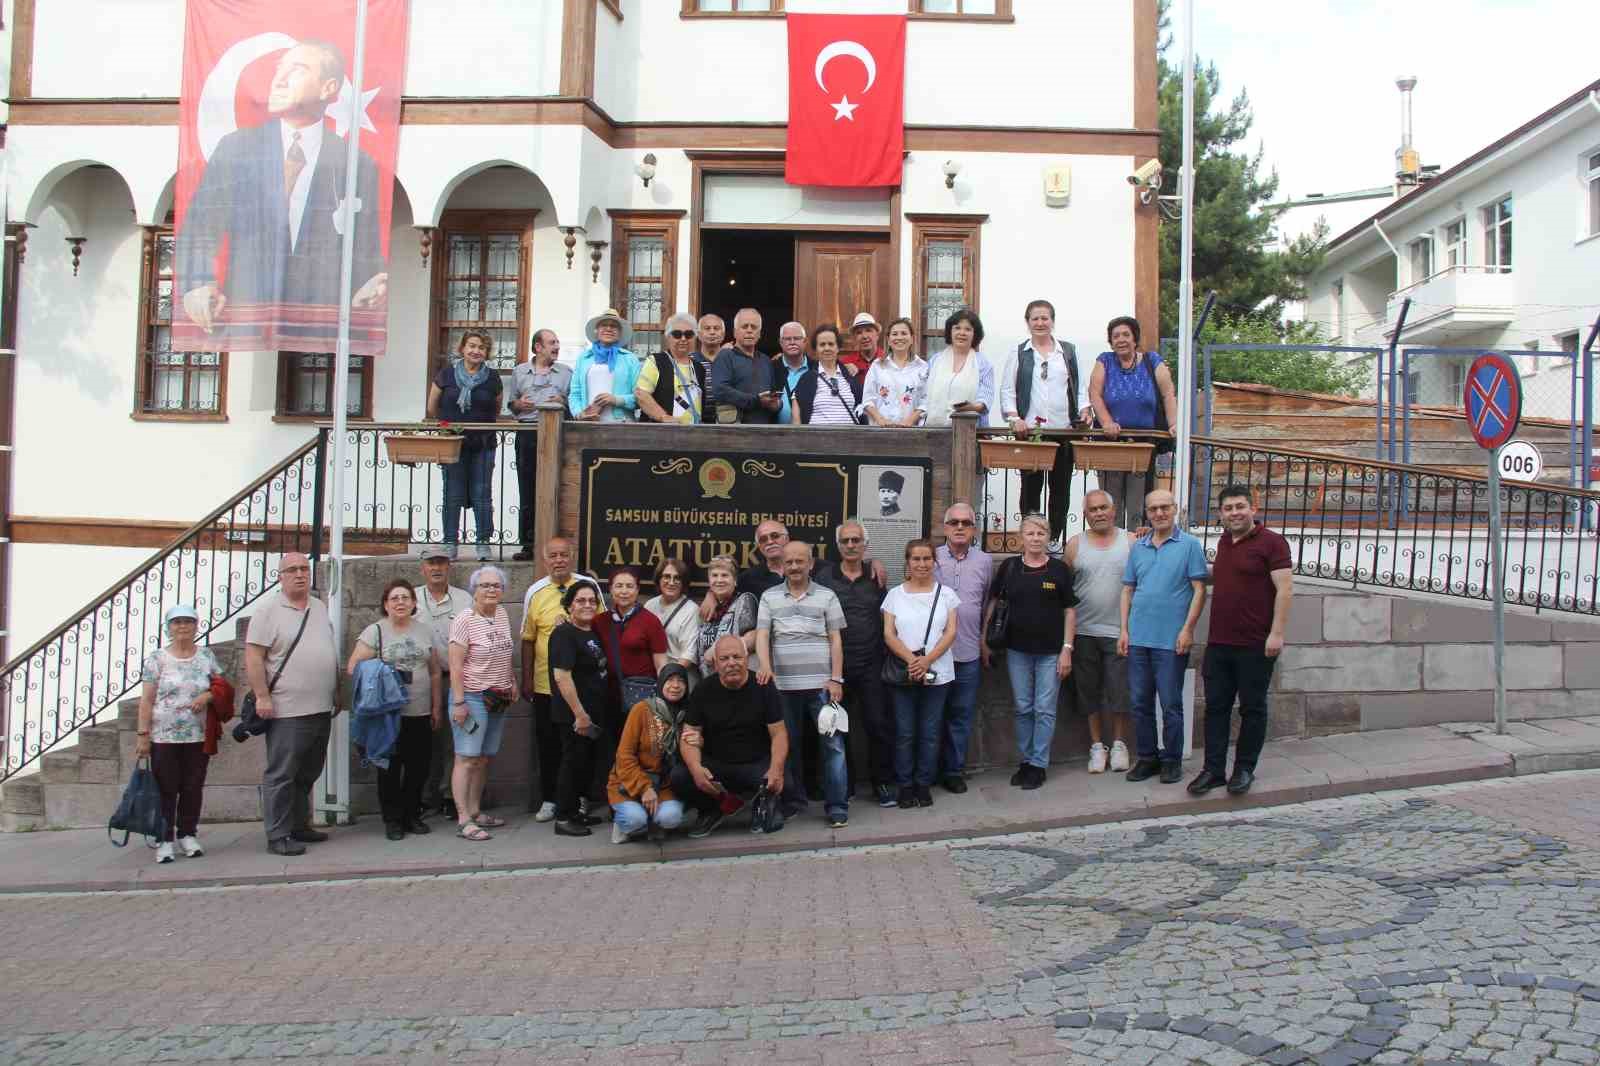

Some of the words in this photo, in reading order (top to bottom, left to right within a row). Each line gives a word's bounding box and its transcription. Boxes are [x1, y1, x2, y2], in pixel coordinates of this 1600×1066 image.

[1503, 455, 1534, 474] 006
[605, 508, 660, 523] SAMSUN
[664, 507, 748, 527] BÜYÜKŞEHİR
